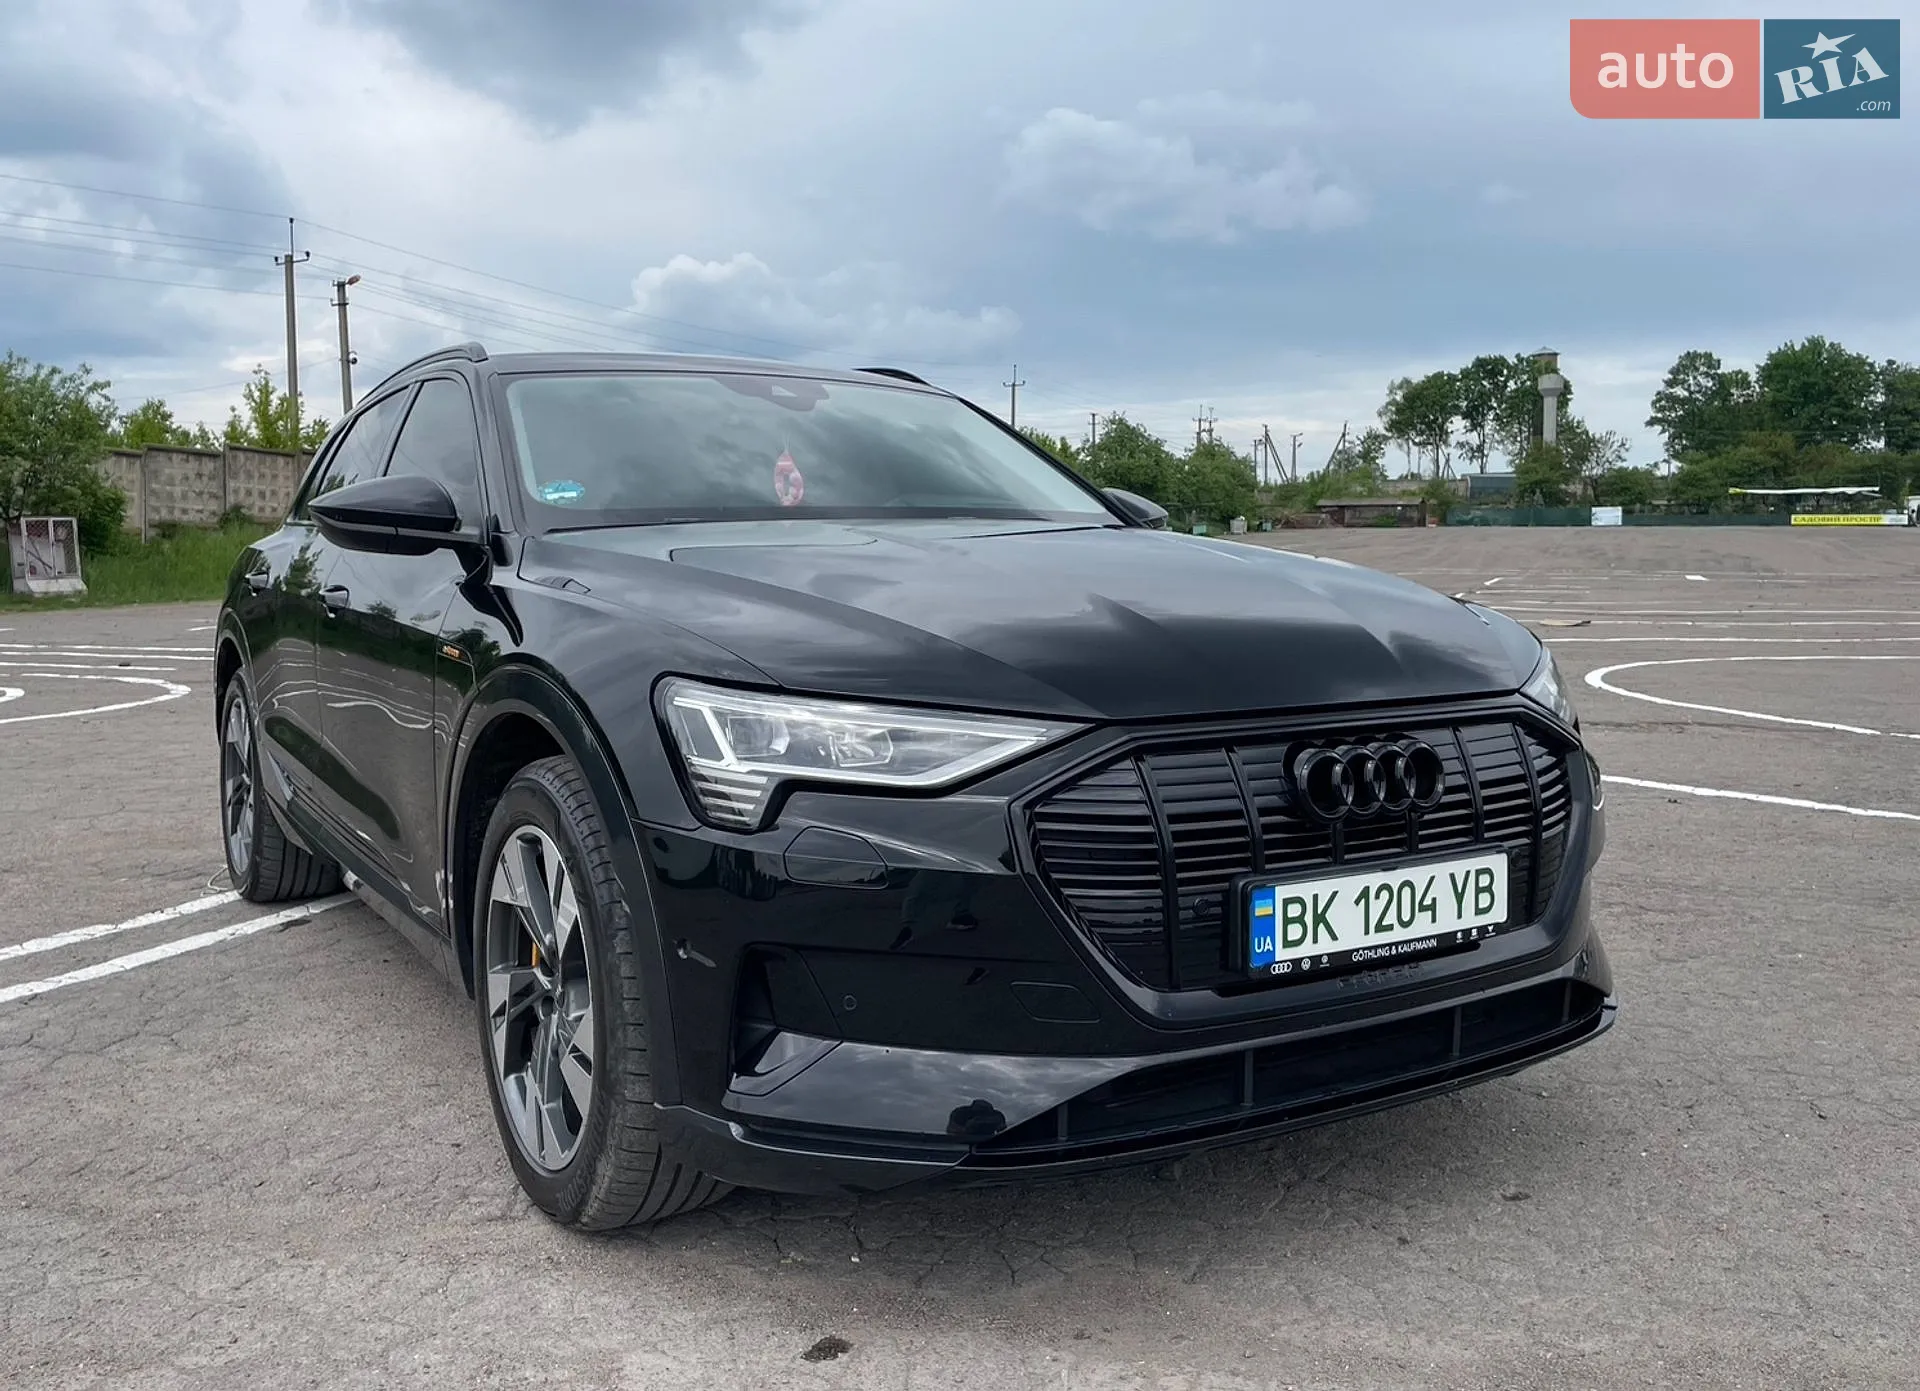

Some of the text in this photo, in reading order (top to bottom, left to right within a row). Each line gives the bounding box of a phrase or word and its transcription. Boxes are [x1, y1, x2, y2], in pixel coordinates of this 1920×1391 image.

[1282, 867, 1495, 949] BK 1204 YB
[1255, 936, 1273, 953] UA
[1351, 938, 1438, 962] GÖTHLING & KAUFMANN
